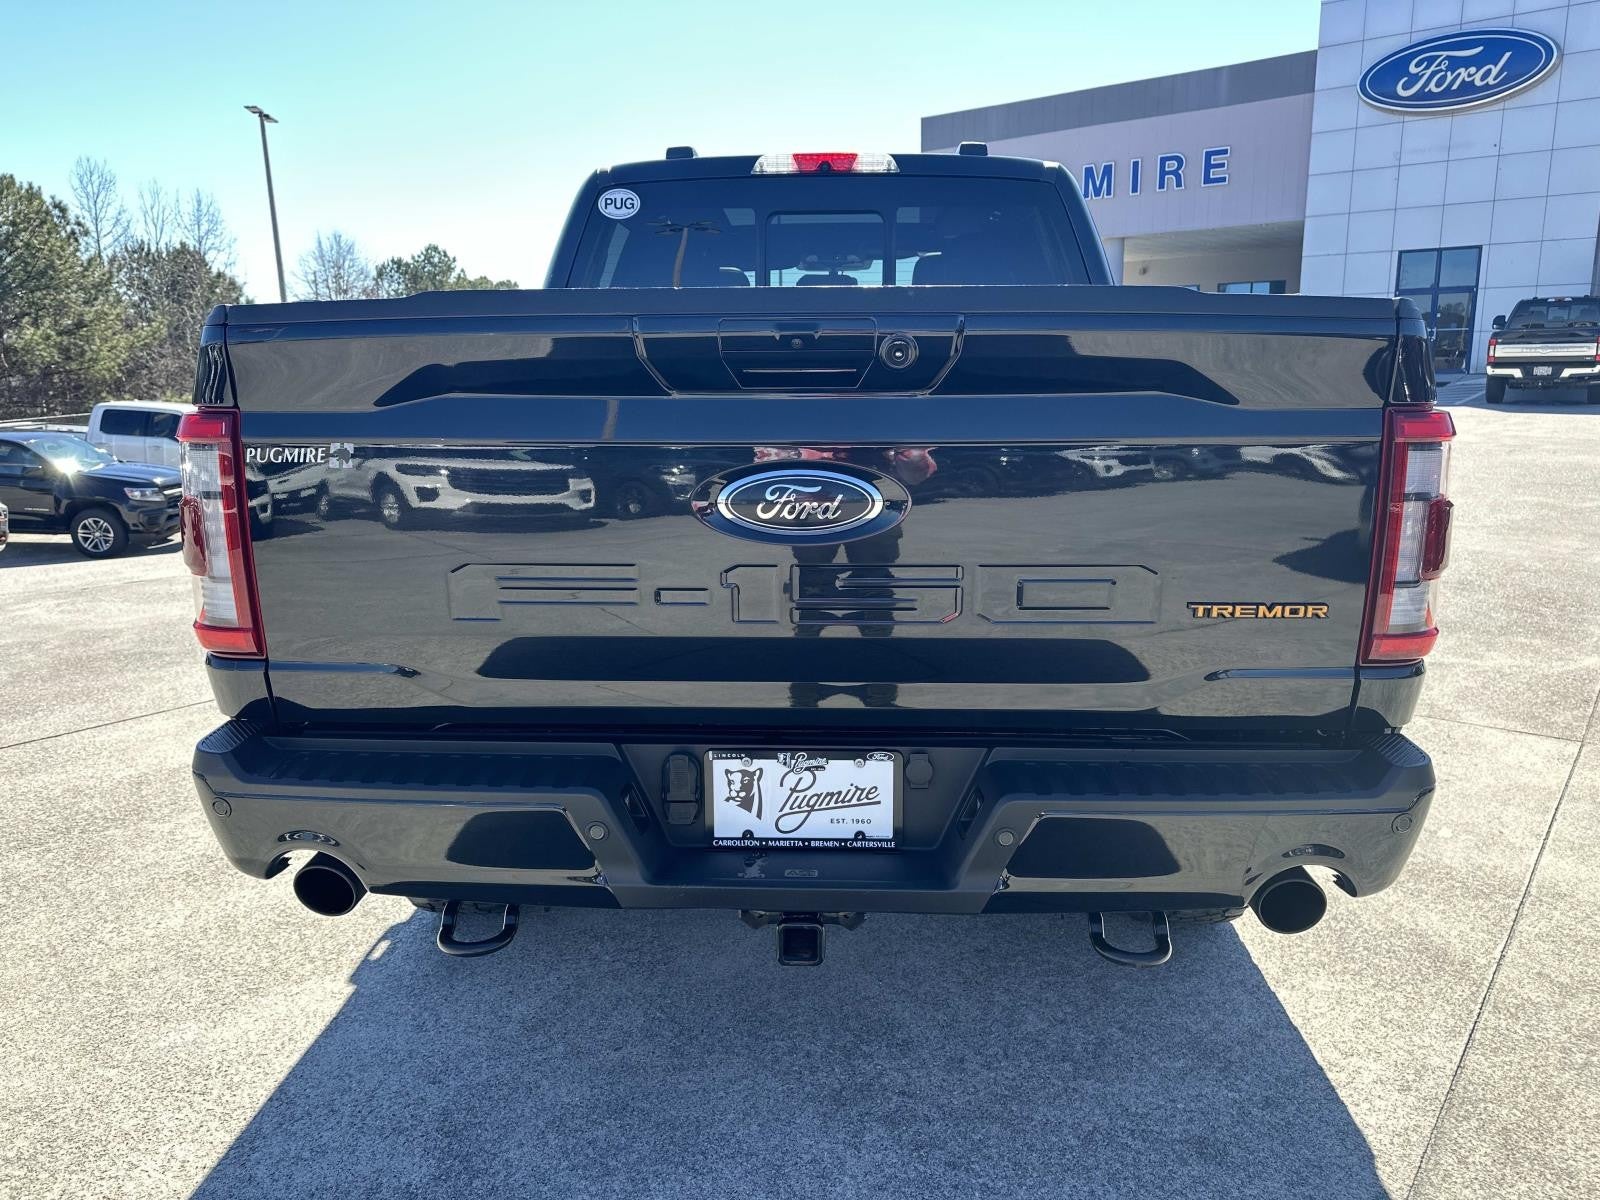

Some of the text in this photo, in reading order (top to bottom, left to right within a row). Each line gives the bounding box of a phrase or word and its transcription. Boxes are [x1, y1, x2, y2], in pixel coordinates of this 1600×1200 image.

[1396, 46, 1512, 97] Ford
[1082, 146, 1231, 201] MIRE
[604, 197, 635, 210] PUG
[246, 447, 326, 464] PUGMIRE
[756, 484, 843, 520] Ford
[448, 563, 1161, 625] F-150
[1187, 602, 1329, 619] TREMOR
[775, 768, 881, 834] Pugmire
[713, 839, 896, 849] CARROLLTON MARIETTA BREMEN CARTERSVILLE
